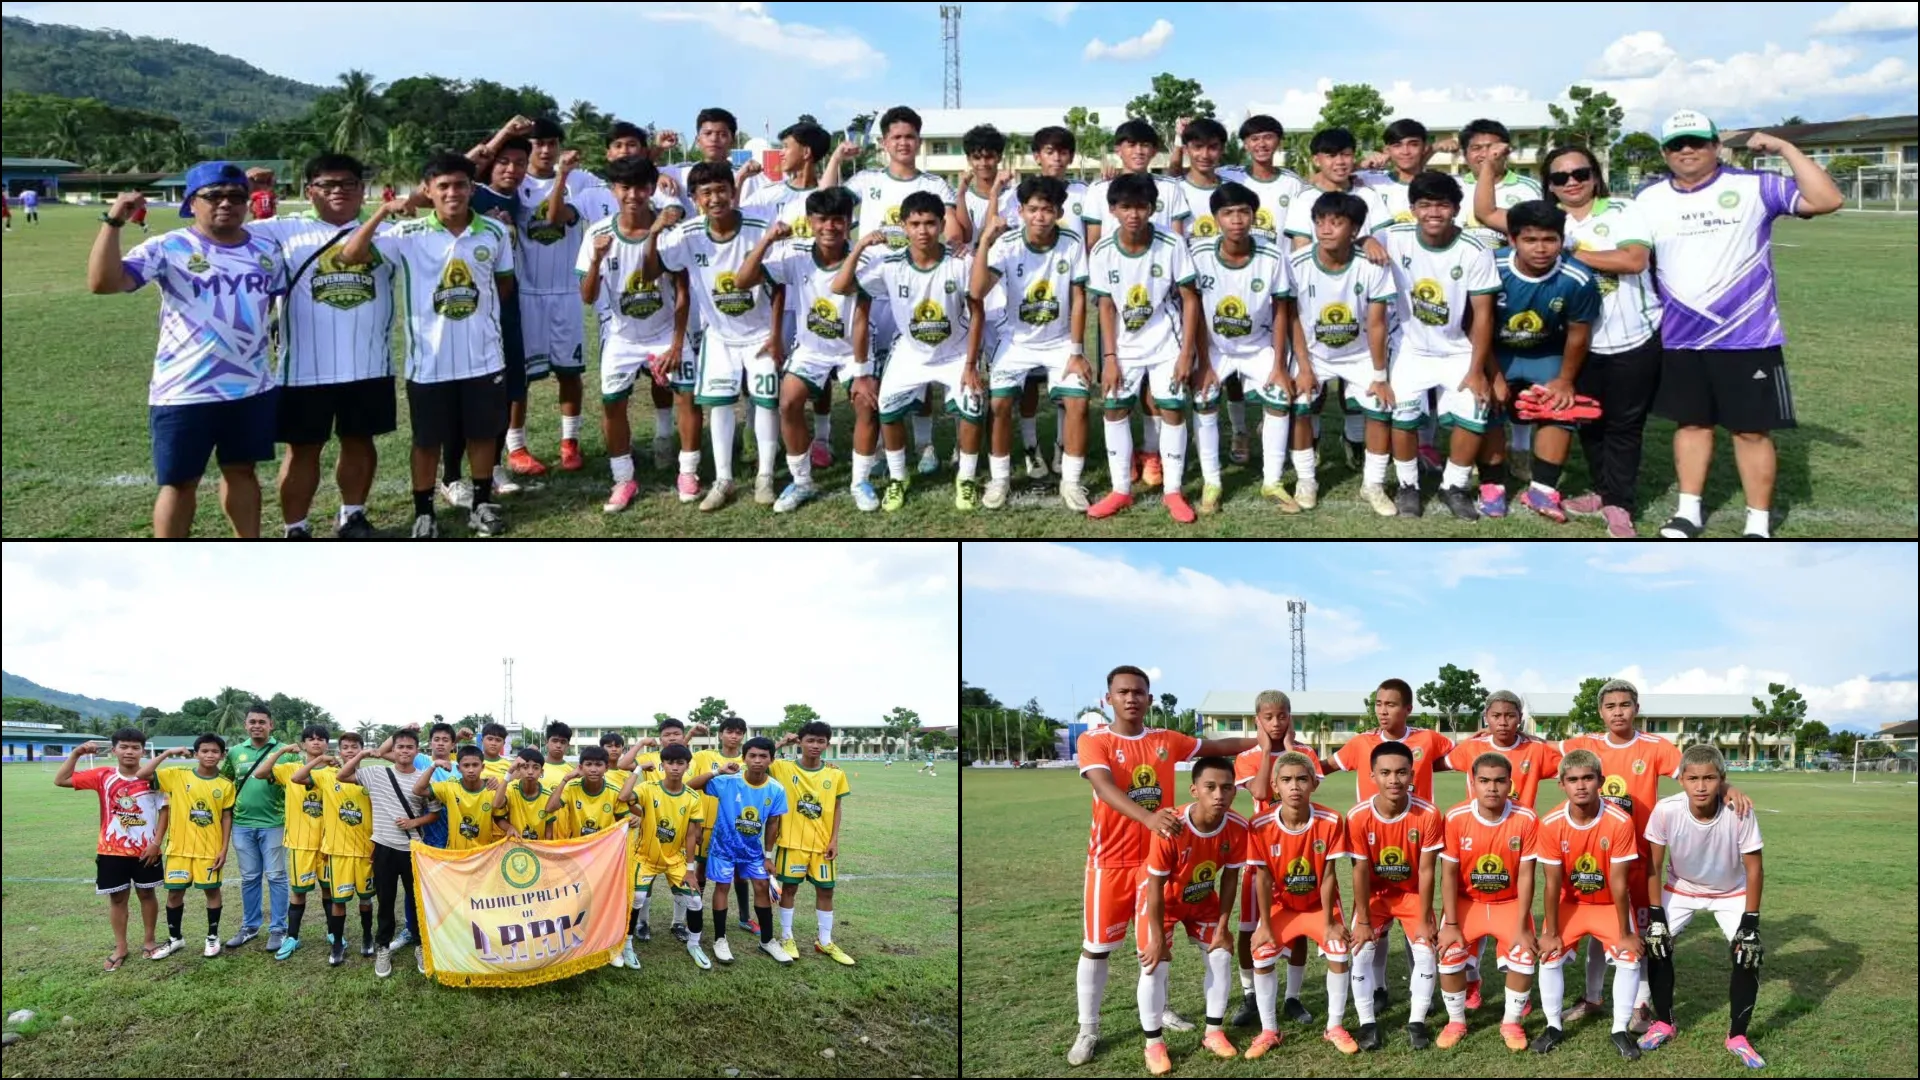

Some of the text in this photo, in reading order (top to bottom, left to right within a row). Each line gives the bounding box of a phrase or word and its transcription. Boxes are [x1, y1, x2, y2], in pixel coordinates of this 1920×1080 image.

[1017, 263, 1024, 278] 5
[1108, 269, 1120, 285] 15
[1201, 274, 1215, 290] 22
[898, 284, 909, 299] 13
[1308, 284, 1316, 298] 11
[572, 343, 583, 364] 4
[678, 361, 694, 380] 16
[754, 374, 776, 396] 20
[1115, 749, 1126, 764] 5
[1368, 831, 1376, 845] 9
[206, 867, 213, 881] 7
[820, 864, 828, 879] 11
[470, 883, 581, 910] MUNICIPALITY
[522, 909, 535, 918] OF
[1637, 907, 1649, 926] 8
